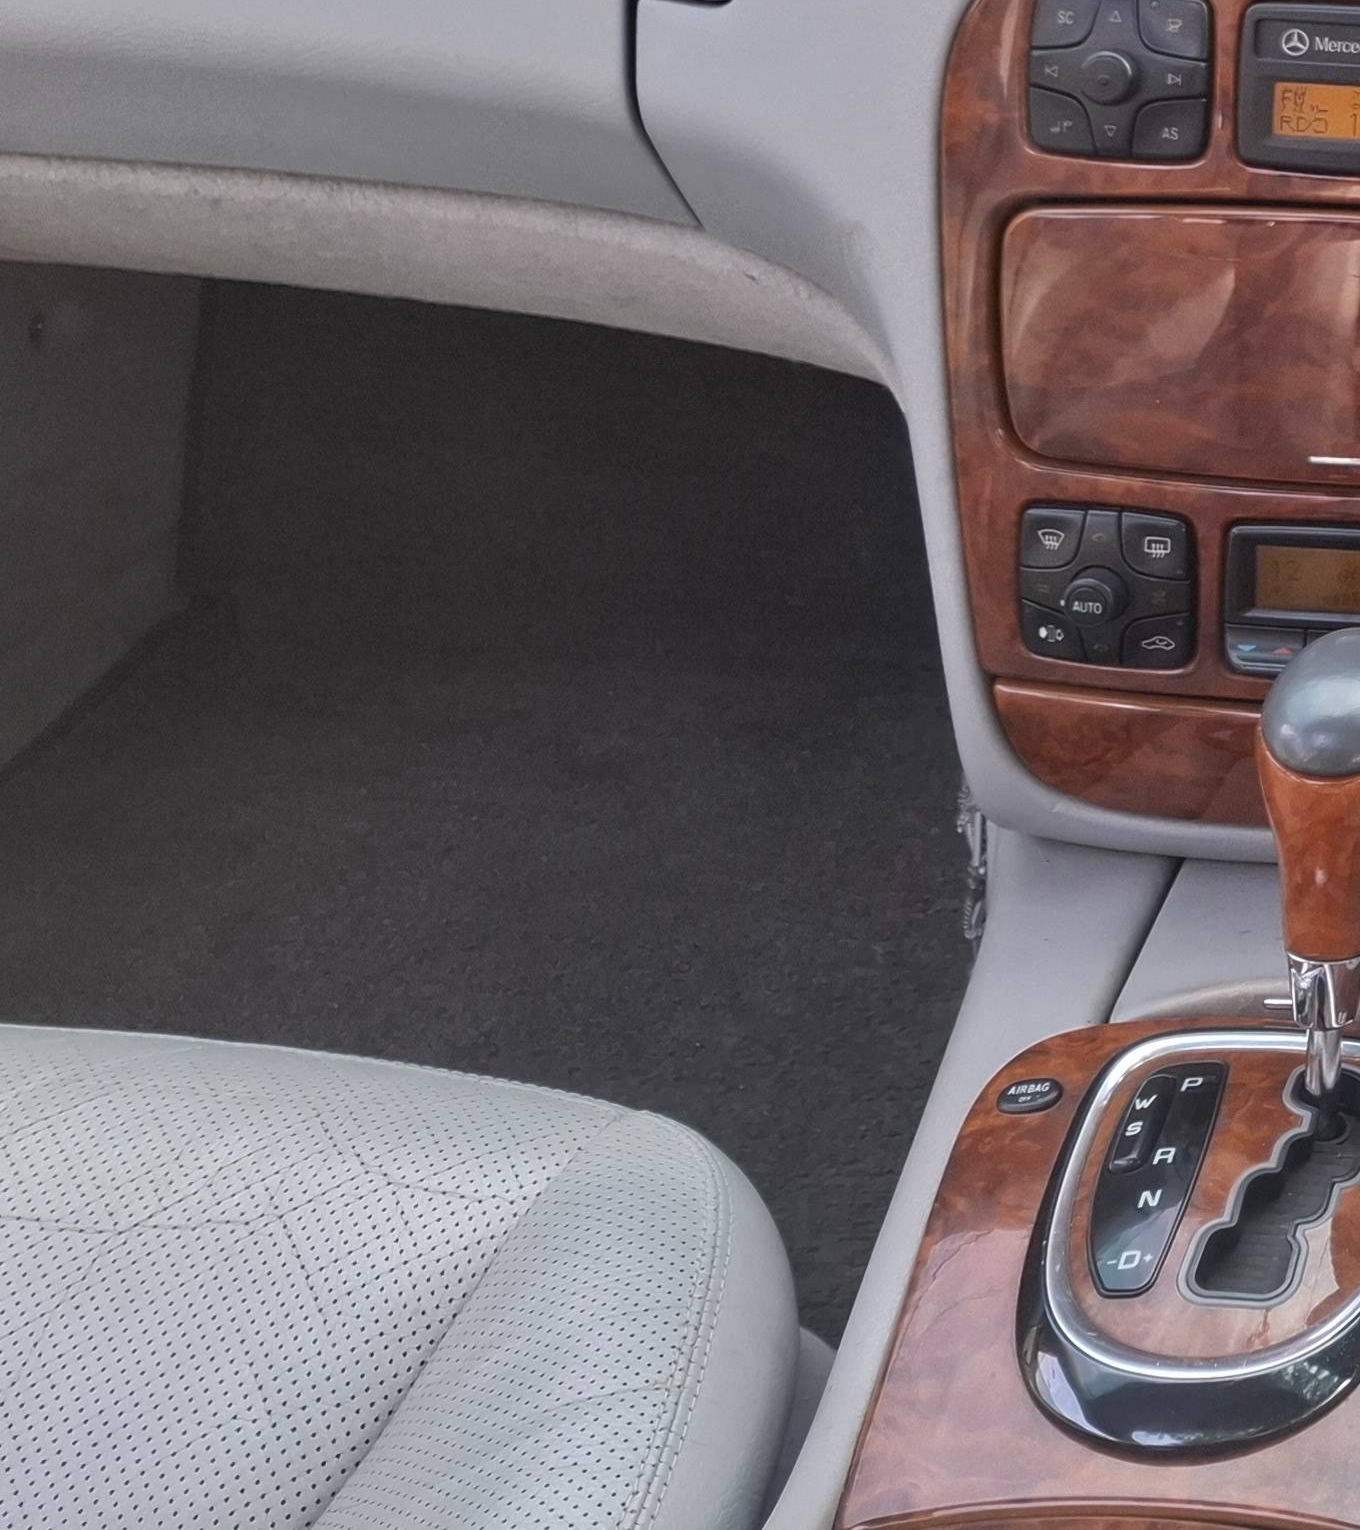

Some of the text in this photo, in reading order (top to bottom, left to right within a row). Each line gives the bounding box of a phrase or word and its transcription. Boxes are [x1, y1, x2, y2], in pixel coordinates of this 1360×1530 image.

[1057, 10, 1075, 24] SC
[1161, 127, 1179, 141] AS
[1072, 600, 1103, 614] AUTO
[1007, 1081, 1050, 1095] AIRBAG
[1180, 1077, 1204, 1092] P
[1135, 1094, 1159, 1110] W
[1125, 1121, 1144, 1136] S
[1137, 1189, 1163, 1208] N
